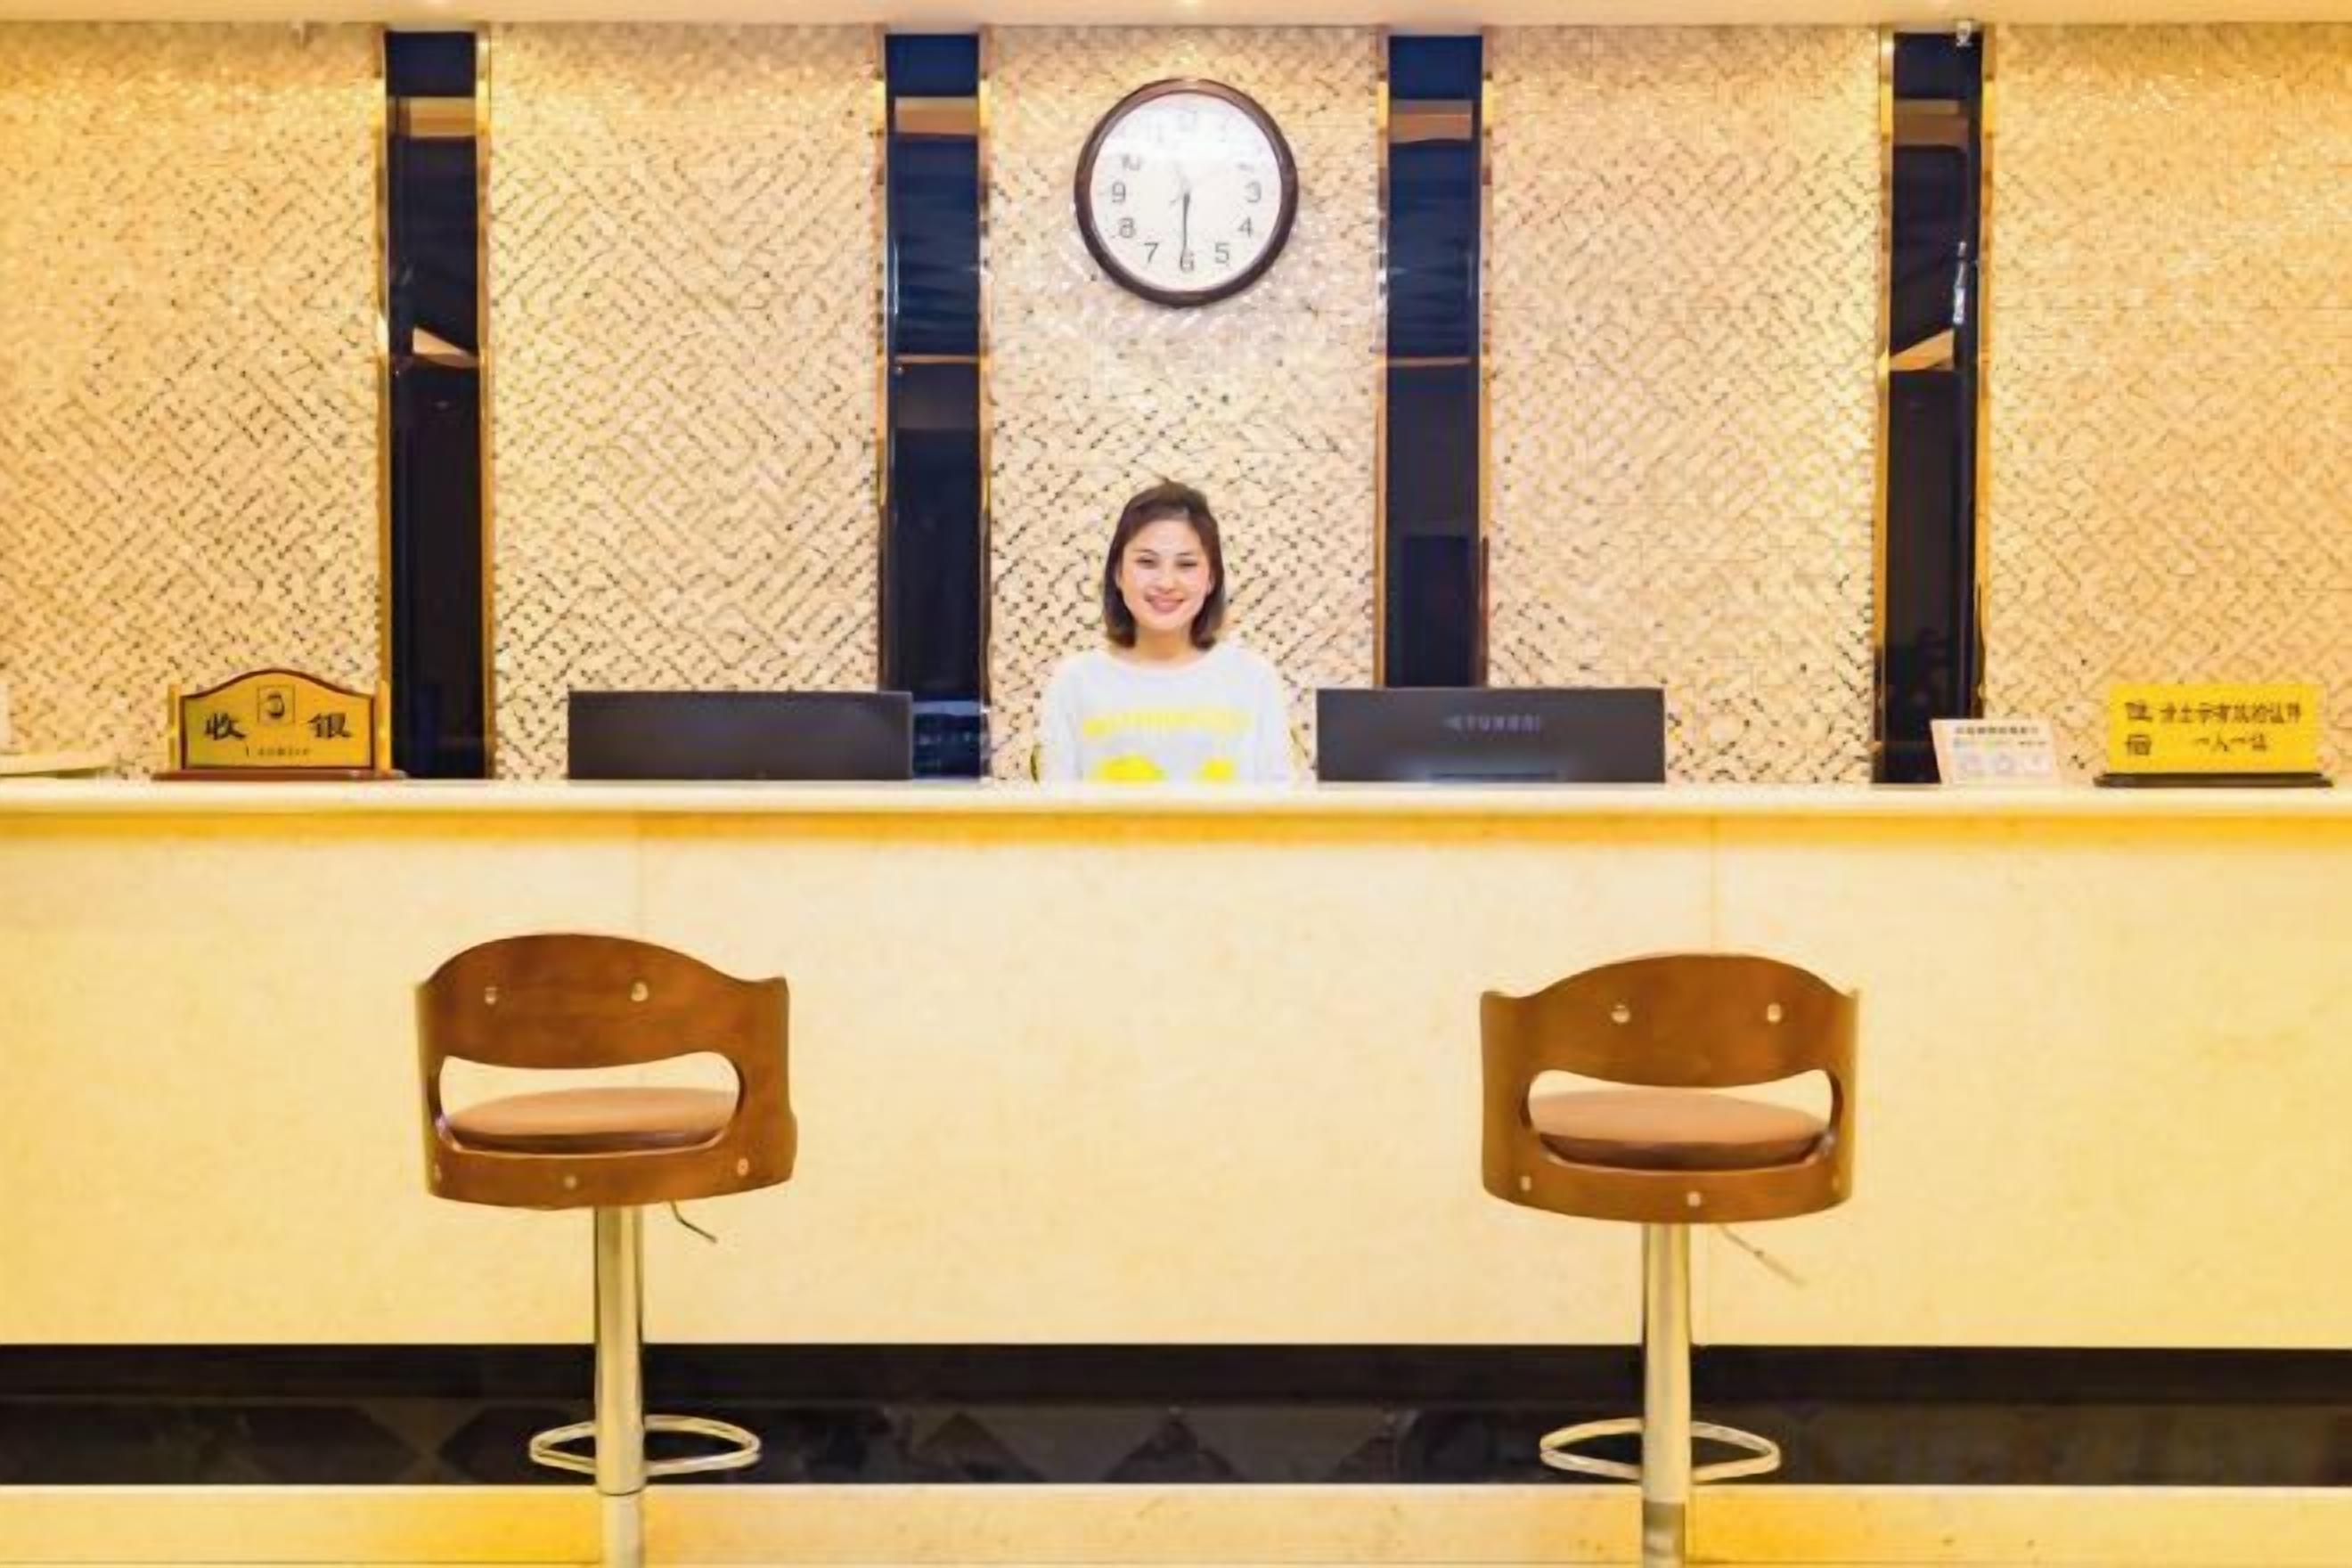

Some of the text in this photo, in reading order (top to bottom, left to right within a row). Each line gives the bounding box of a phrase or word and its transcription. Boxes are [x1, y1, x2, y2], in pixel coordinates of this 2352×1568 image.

[1112, 181, 1126, 203] 9
[1245, 181, 1262, 203] 3
[1118, 217, 1135, 239] 8
[1237, 216, 1254, 238] 4
[1144, 242, 1159, 263] 7
[1214, 242, 1230, 264] 5
